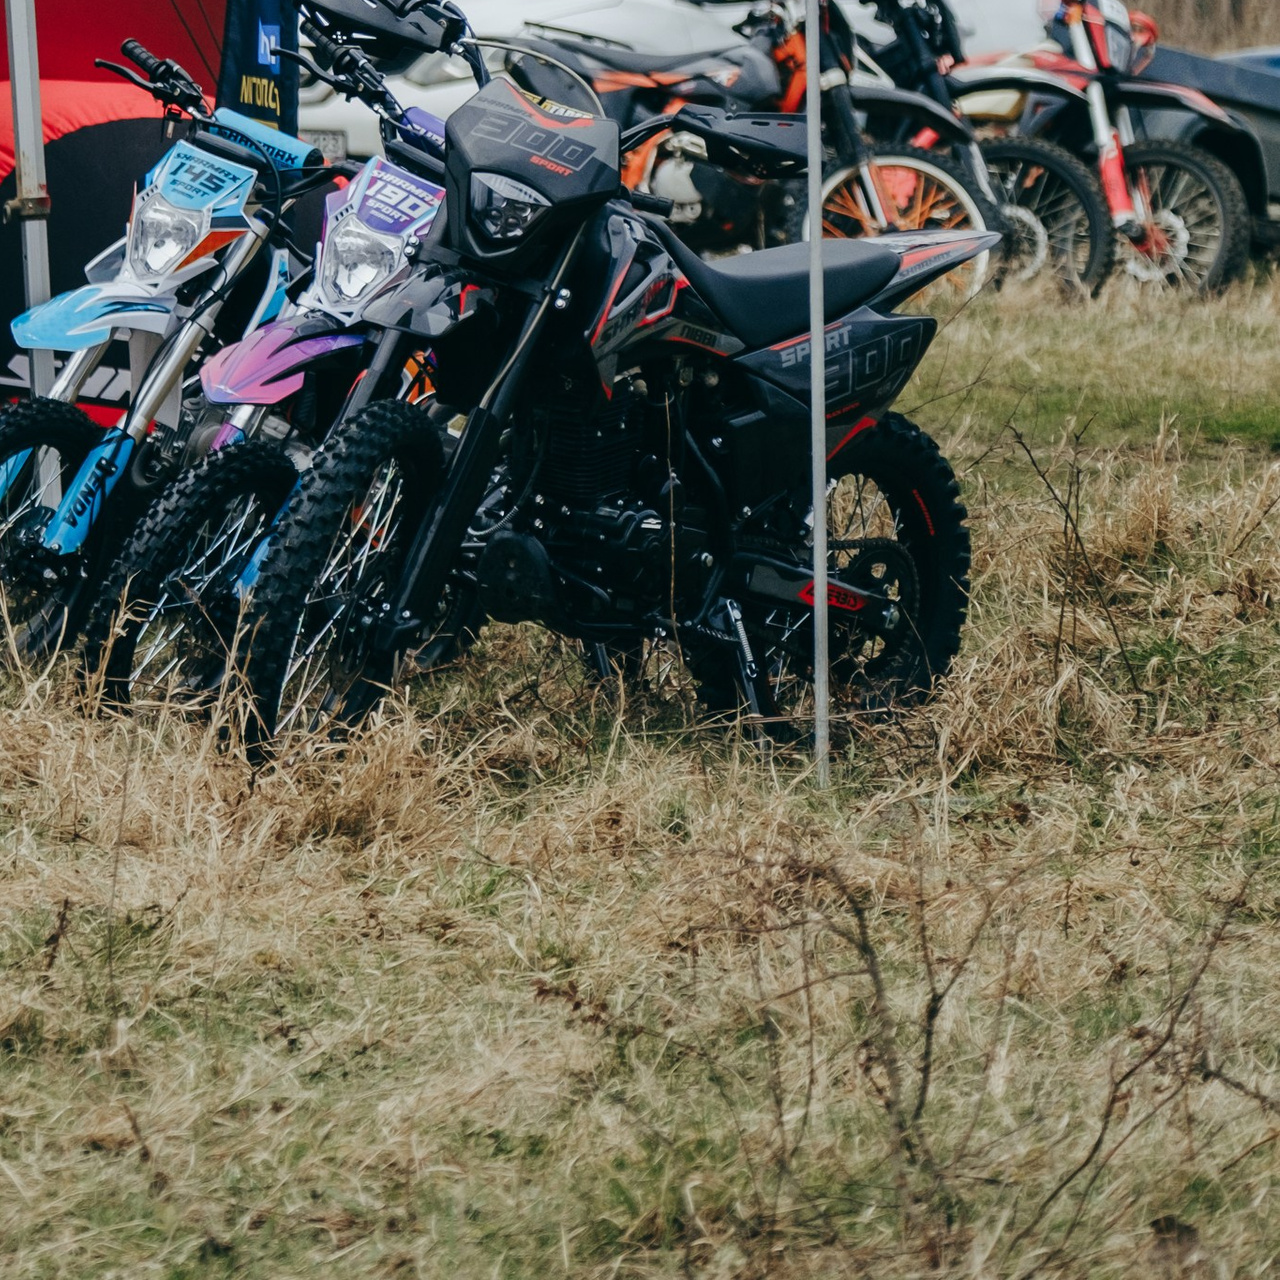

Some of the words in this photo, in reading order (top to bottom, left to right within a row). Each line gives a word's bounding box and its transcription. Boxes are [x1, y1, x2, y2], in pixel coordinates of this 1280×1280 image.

[470, 111, 598, 172] 300
[169, 162, 226, 194] 145
[173, 152, 242, 184] SHARMAX
[529, 154, 574, 177] SPORT
[169, 178, 211, 198] SPORT
[365, 179, 434, 219] 190
[365, 198, 411, 223] SPORT
[779, 325, 852, 368] SPRT
